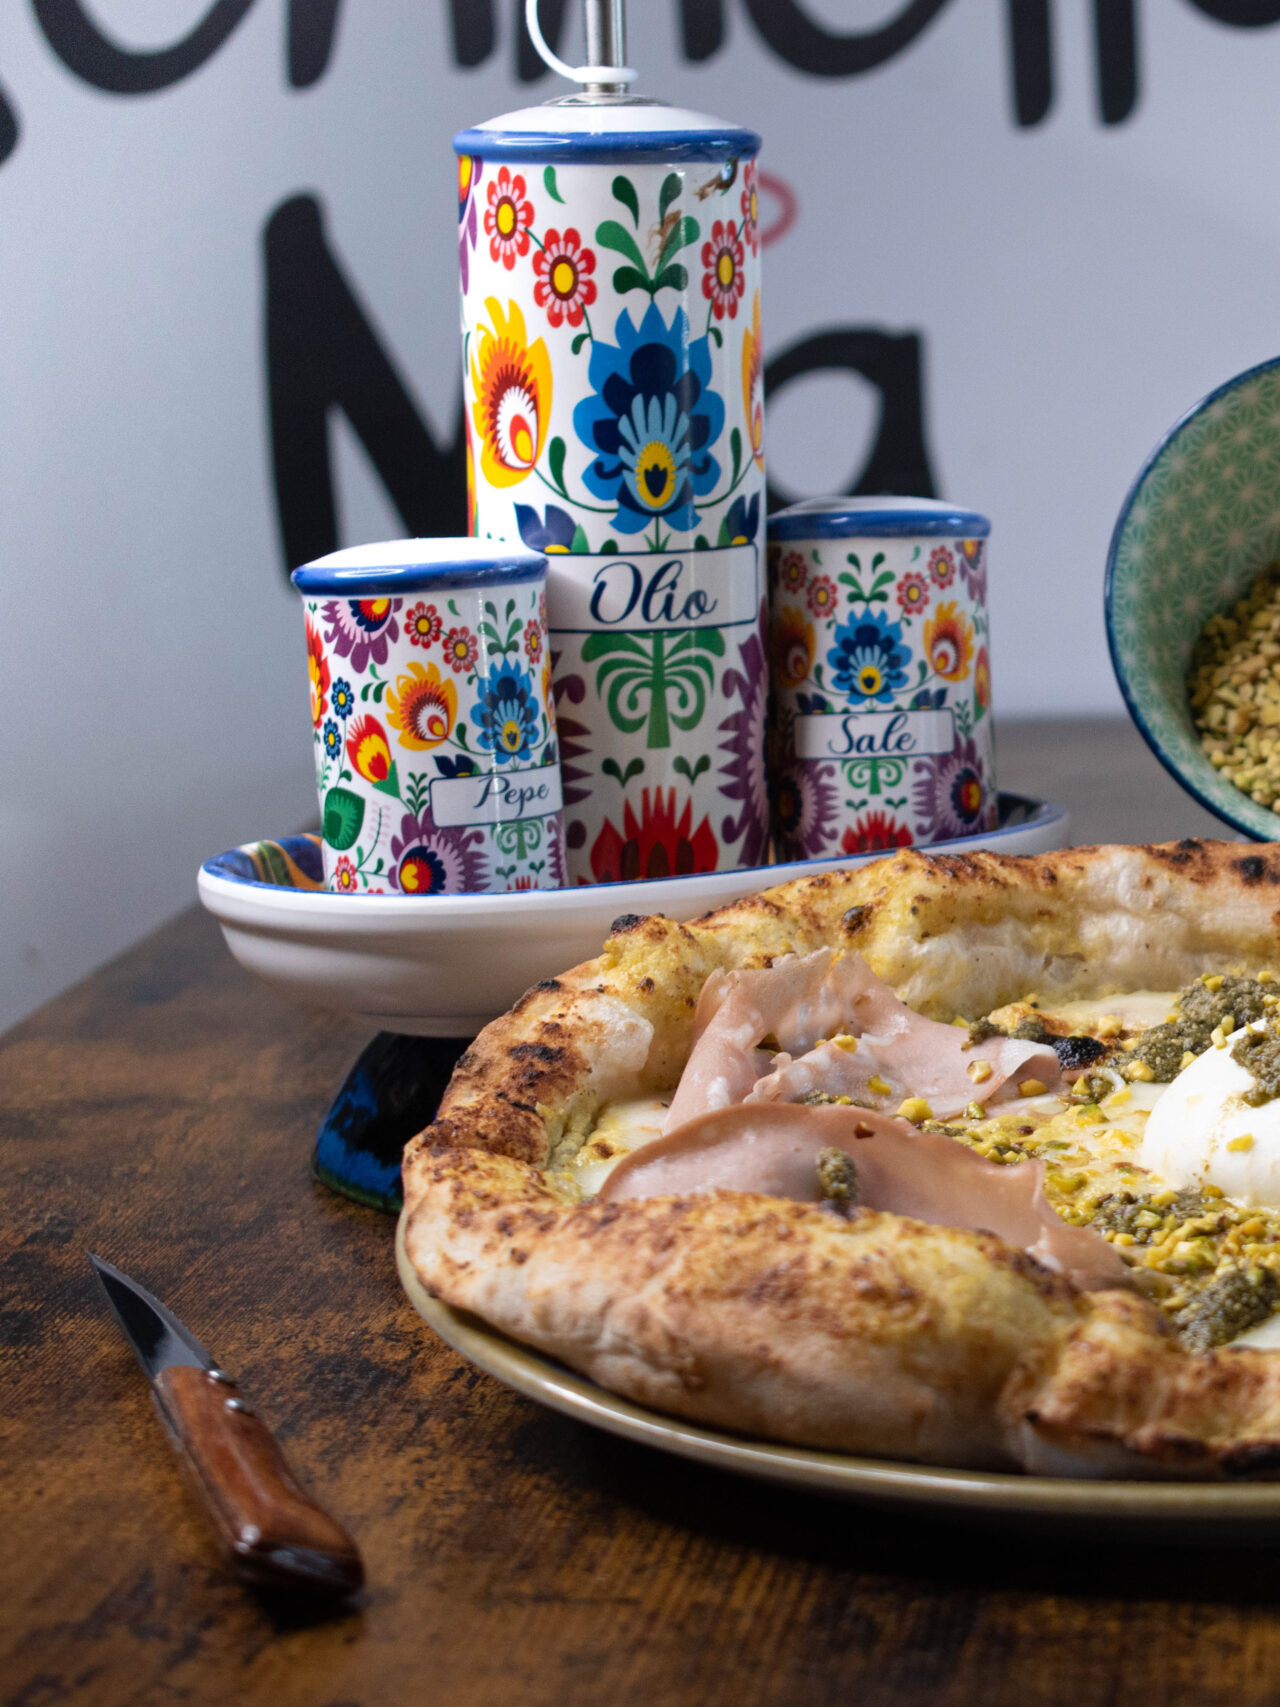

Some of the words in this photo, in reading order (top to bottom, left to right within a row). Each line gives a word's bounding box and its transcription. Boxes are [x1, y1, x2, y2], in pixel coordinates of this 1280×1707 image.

[589, 560, 718, 625] Olio
[827, 712, 917, 755] Sale
[472, 775, 551, 818] Pepe
